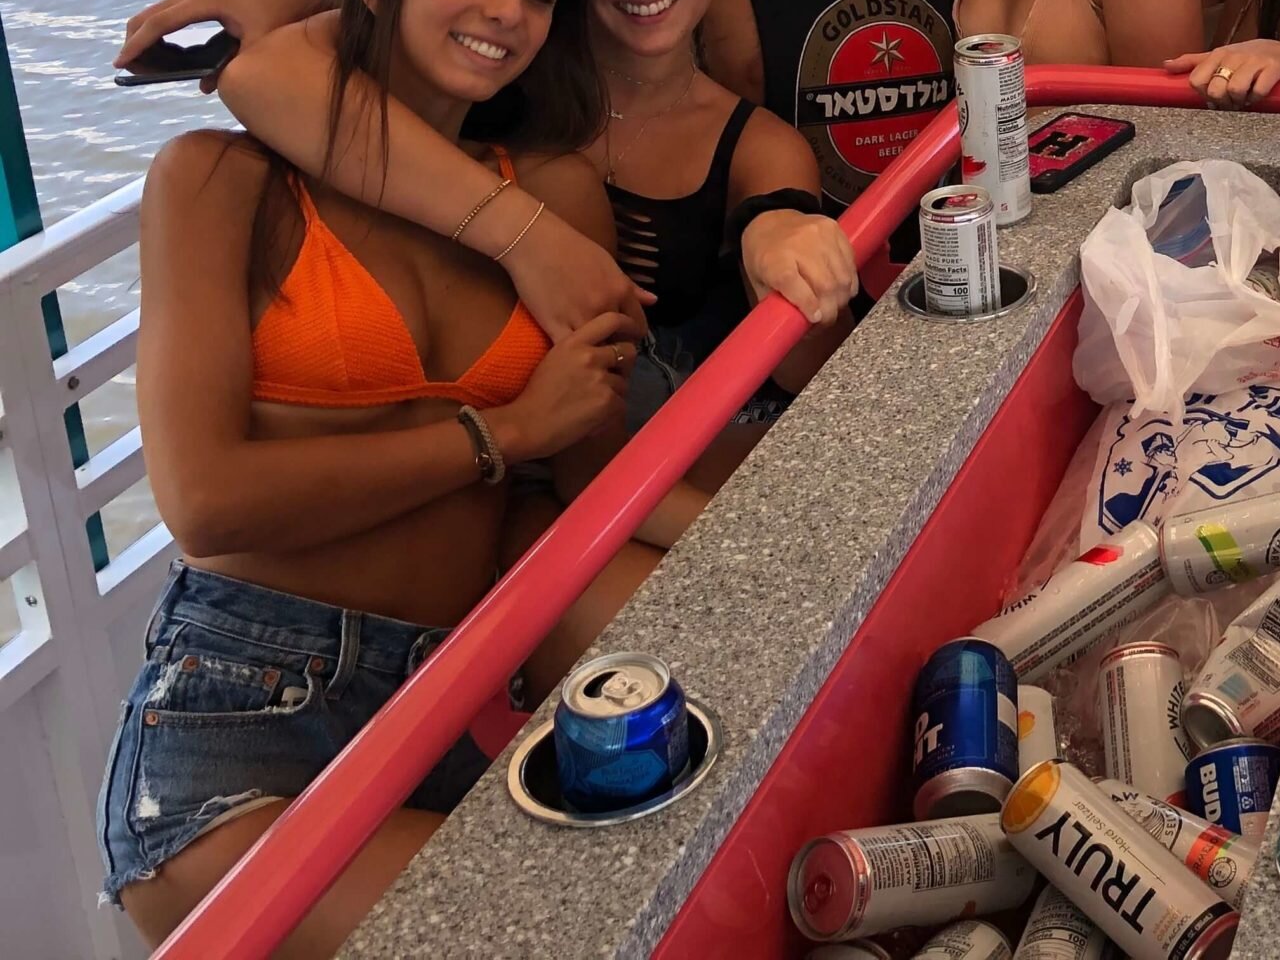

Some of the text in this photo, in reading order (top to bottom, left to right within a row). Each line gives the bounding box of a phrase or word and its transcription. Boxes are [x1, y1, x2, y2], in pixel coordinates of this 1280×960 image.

[855, 129, 919, 146] DARK LAGER
[953, 287, 968, 295] 100
[1167, 681, 1185, 730] WHITE
[1200, 763, 1223, 823] BUD
[1072, 800, 1130, 853] Hard Seltzer
[1035, 811, 1156, 934] TRULY
[1068, 934, 1086, 947] 100
